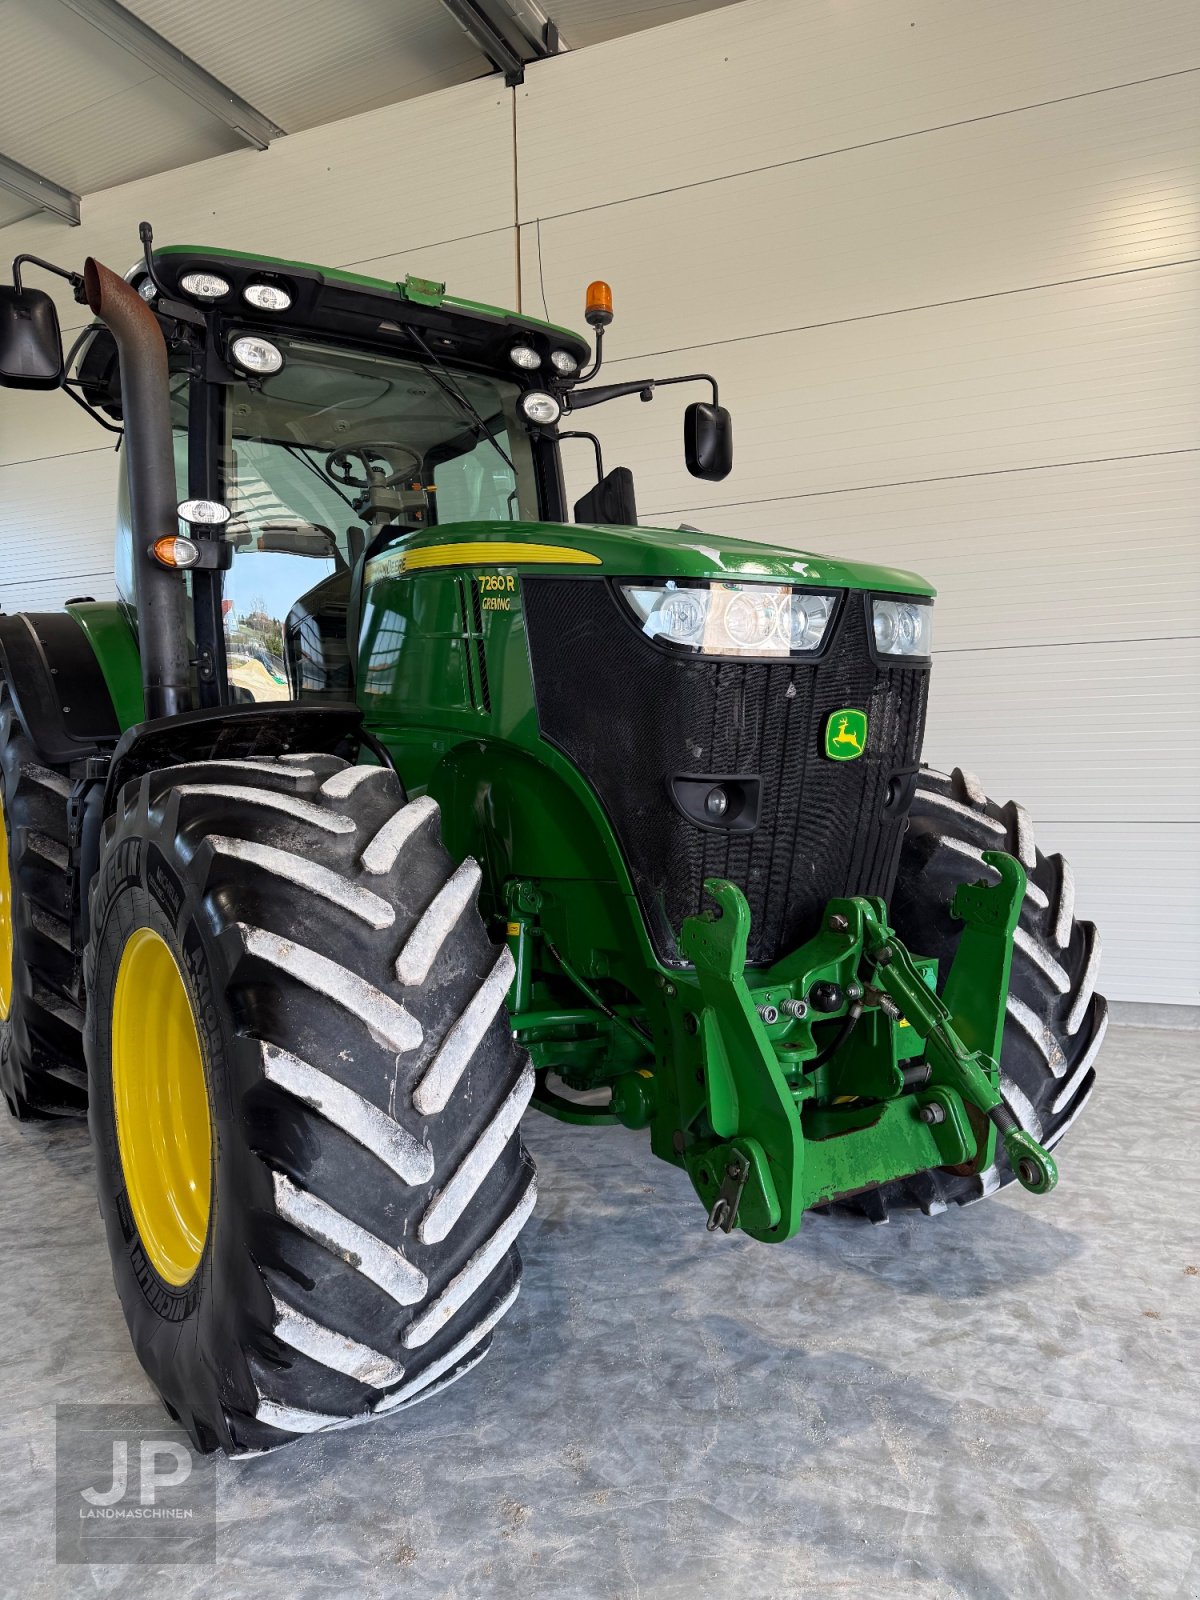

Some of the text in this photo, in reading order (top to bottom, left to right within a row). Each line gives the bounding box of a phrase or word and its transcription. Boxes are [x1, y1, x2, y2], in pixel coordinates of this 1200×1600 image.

[478, 576, 515, 593] 7260 R
[131, 1249, 186, 1321] MICHELIN
